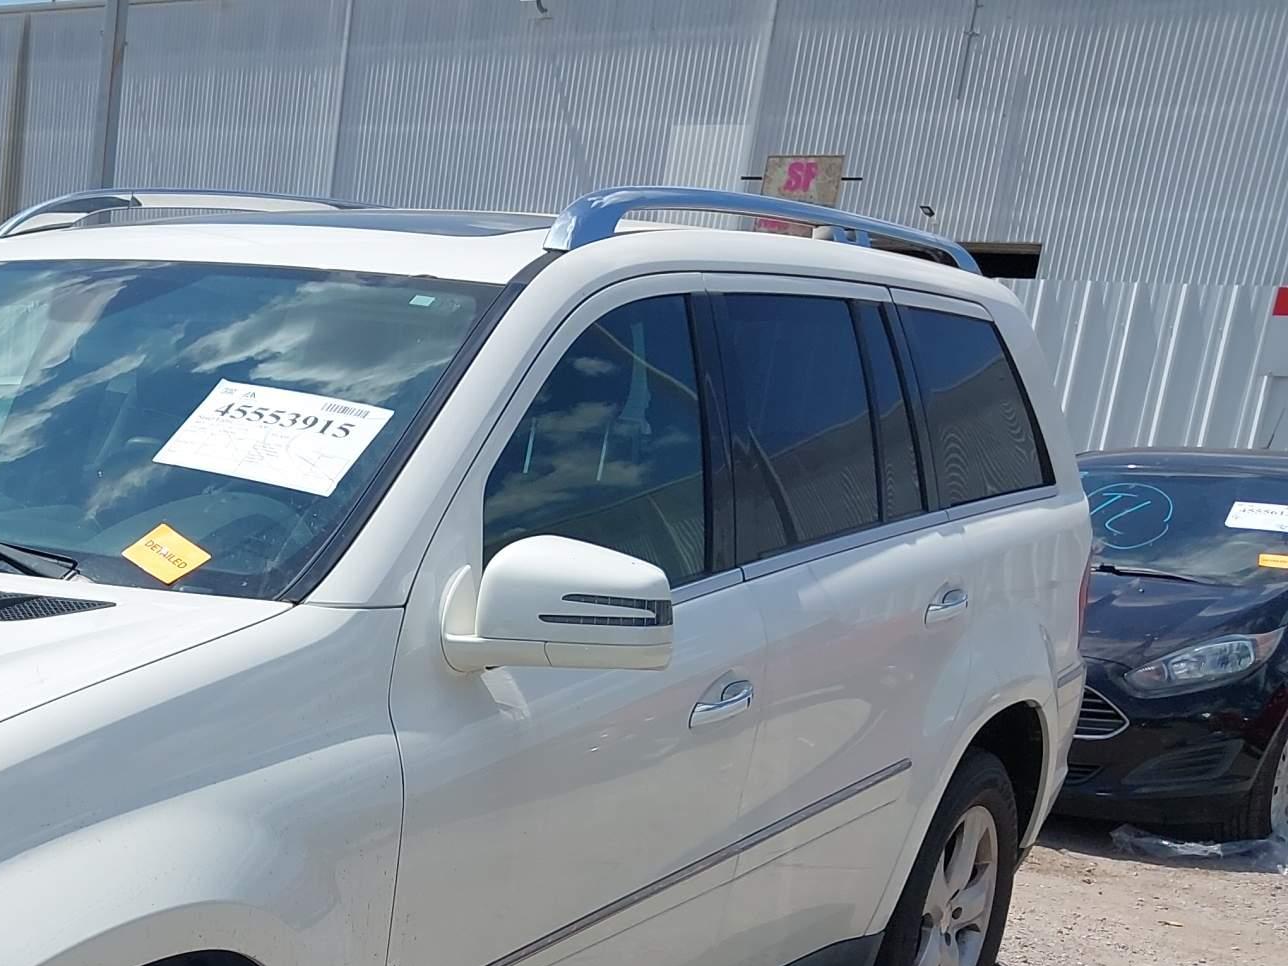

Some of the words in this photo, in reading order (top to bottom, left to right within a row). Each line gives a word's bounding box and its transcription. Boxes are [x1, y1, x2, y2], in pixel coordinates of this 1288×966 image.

[783, 160, 819, 193] SF
[214, 402, 356, 439] 45553915
[144, 539, 188, 569] DETAILED
